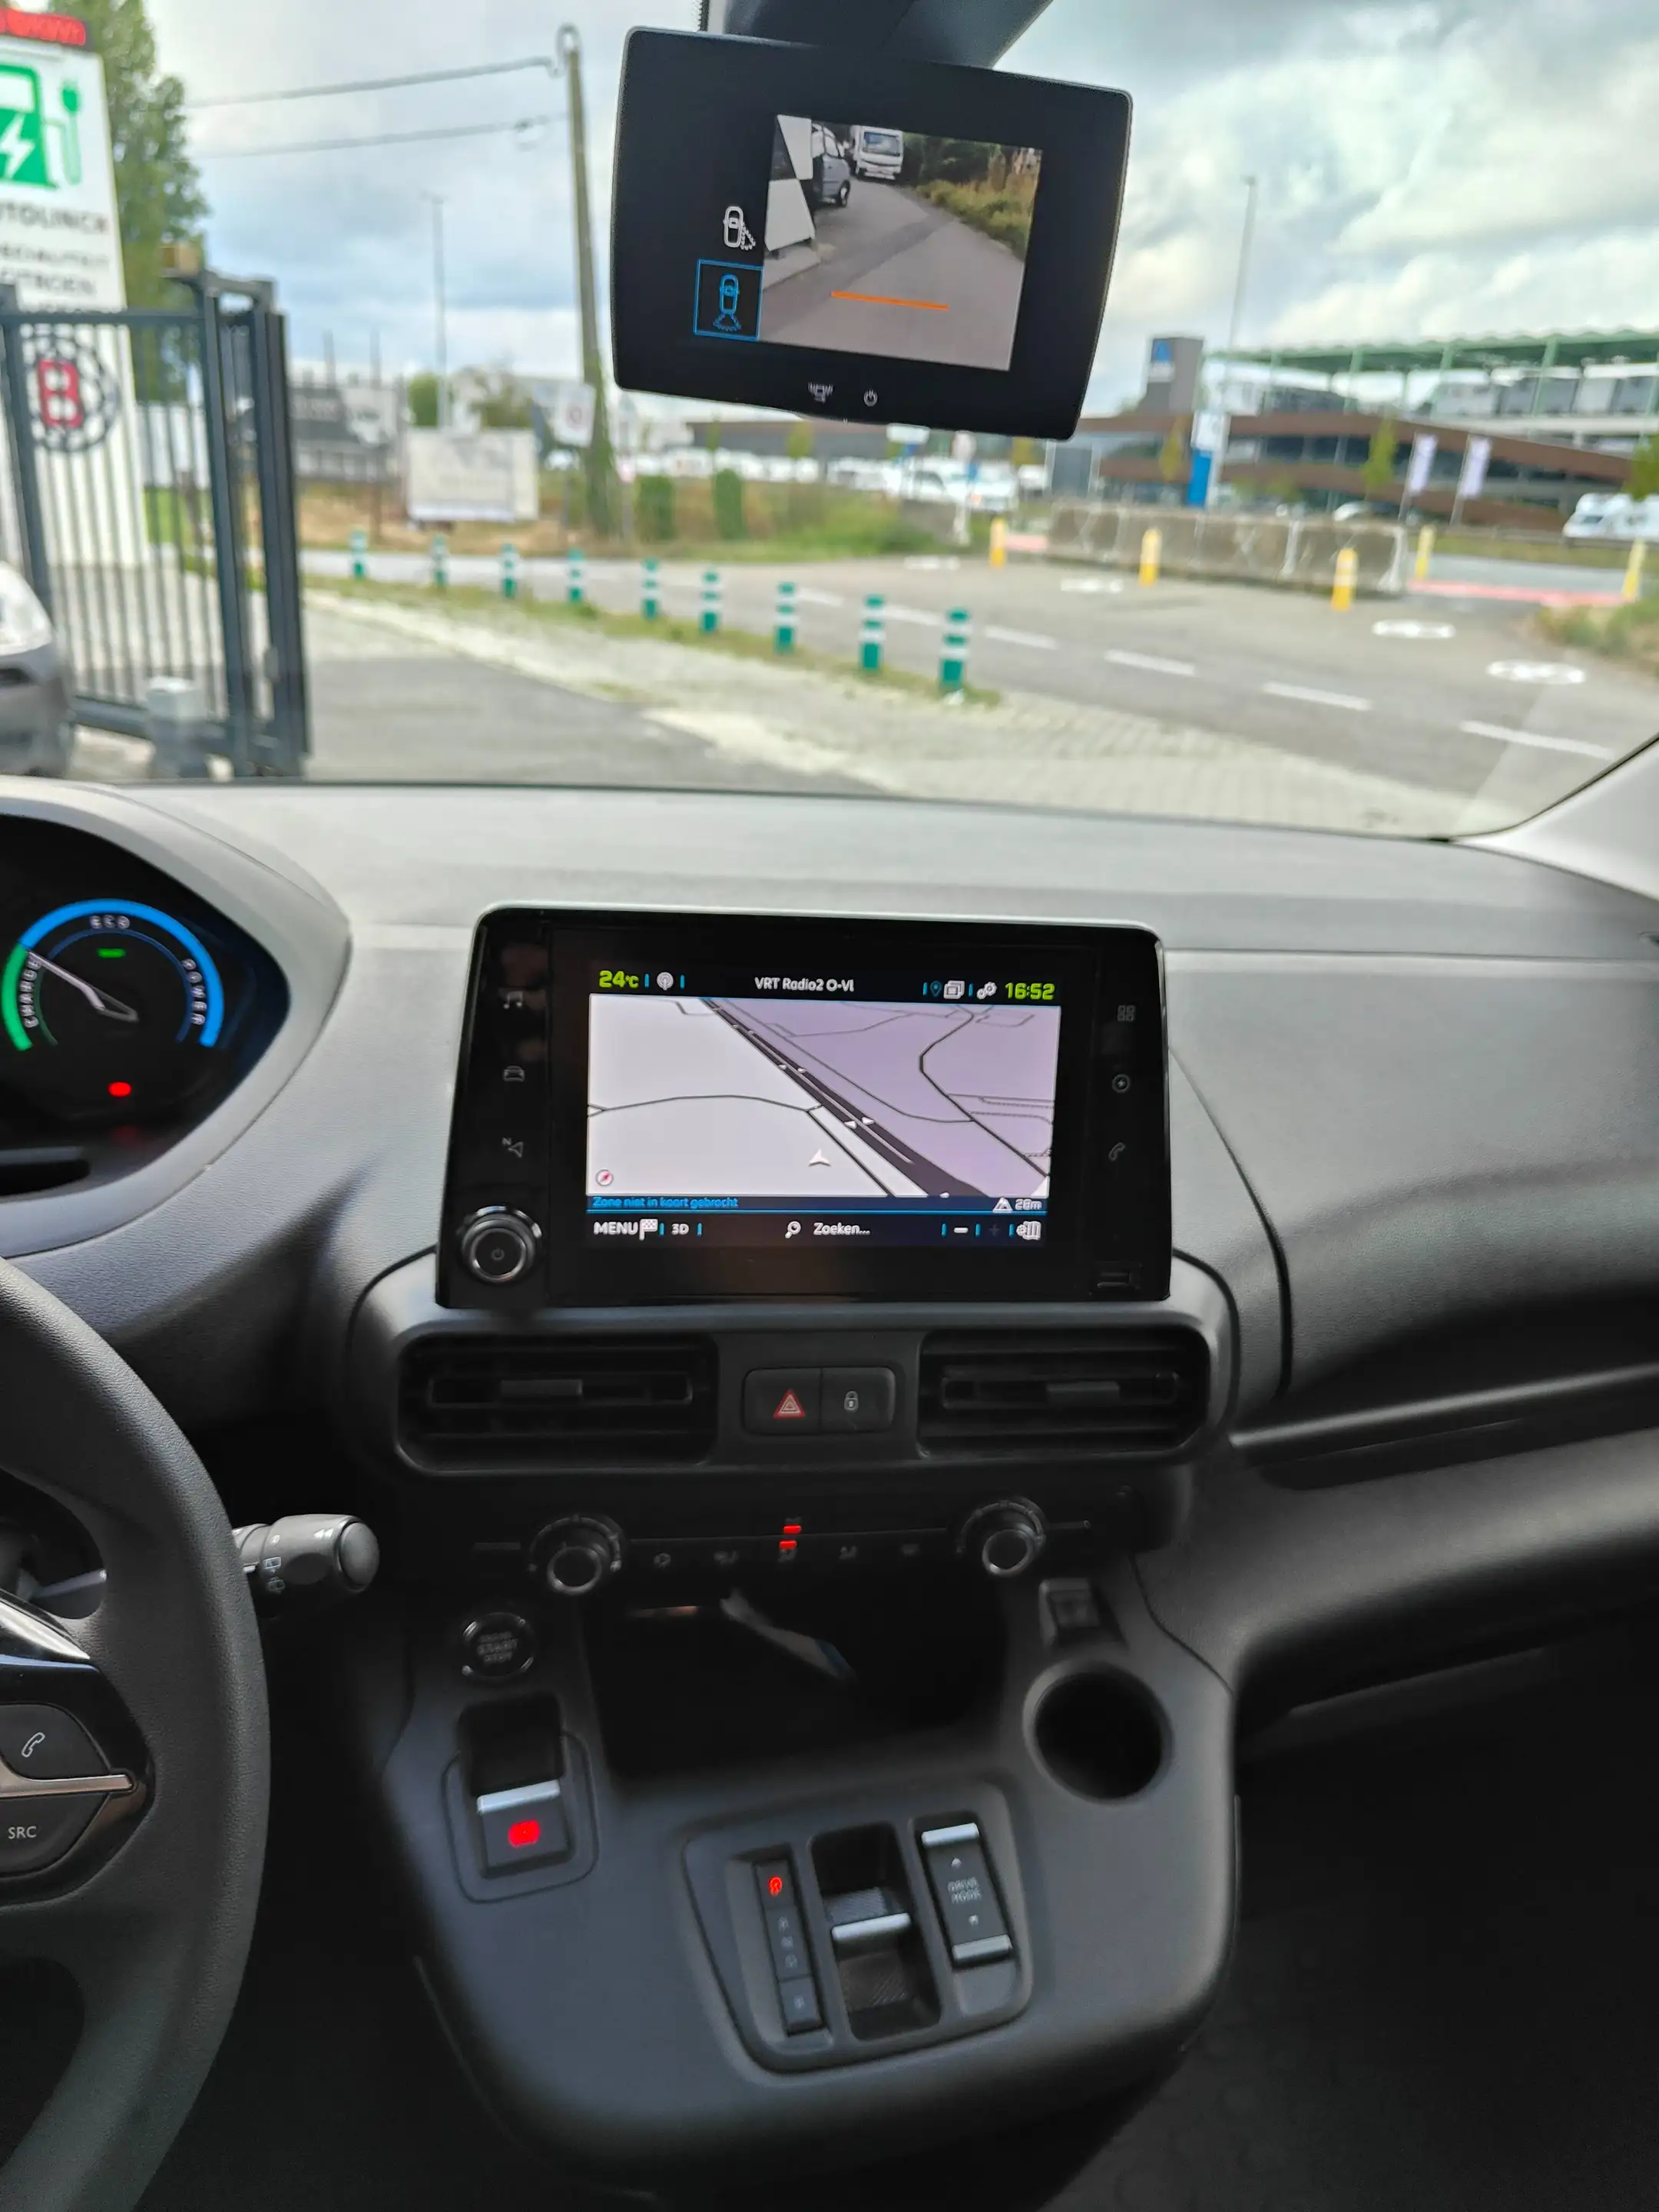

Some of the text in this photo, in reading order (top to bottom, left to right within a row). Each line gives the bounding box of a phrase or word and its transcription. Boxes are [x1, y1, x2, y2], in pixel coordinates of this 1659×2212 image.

[754, 977, 780, 989] VRT
[783, 978, 824, 992] Radio2
[1005, 982, 1055, 1000] 16:52
[592, 1196, 622, 1208] Zone
[624, 1197, 646, 1208] niet
[647, 1197, 658, 1208] in
[593, 1221, 639, 1235] MENU
[671, 1223, 690, 1236] 3D
[813, 1222, 871, 1236] Zoeken...
[8, 1825, 37, 1839] SRC
